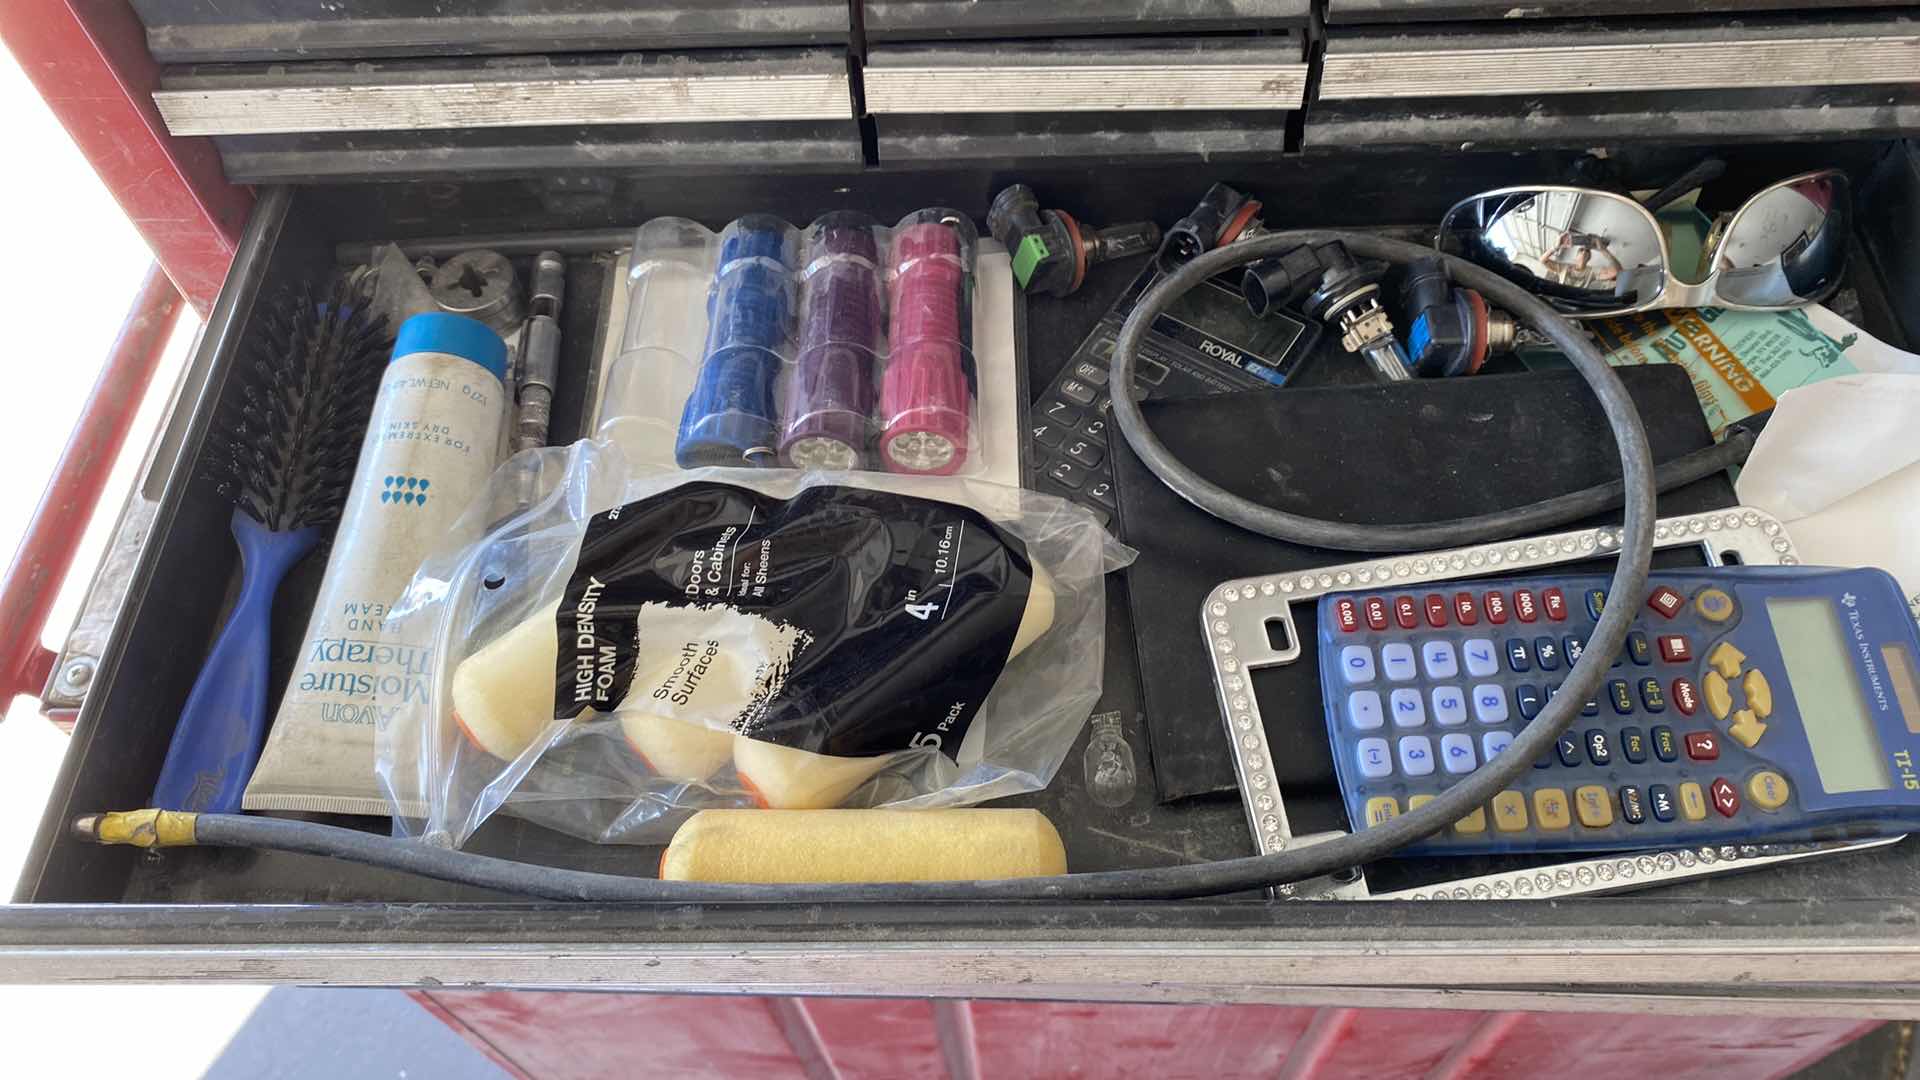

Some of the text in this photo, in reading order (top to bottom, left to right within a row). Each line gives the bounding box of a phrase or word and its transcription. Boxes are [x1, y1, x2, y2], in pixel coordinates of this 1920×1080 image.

[1199, 340, 1243, 368] ROYAL
[1047, 400, 1065, 416] 7
[389, 422, 416, 430] SKIN
[1032, 425, 1048, 437] 4
[1069, 440, 1087, 456] 5
[688, 549, 705, 596] Doors
[706, 526, 736, 597] & Cabinets
[740, 561, 753, 577] for:
[753, 540, 772, 598] All Sheens
[1339, 601, 1352, 625] 0.001
[1370, 602, 1382, 620] 0.01
[1400, 603, 1412, 616] 0.1
[1549, 595, 1560, 609] Fix
[574, 576, 606, 702] HIGH DENSITY
[310, 639, 431, 675] Therapy
[1349, 657, 1364, 667] 0
[1431, 651, 1448, 663] 4
[1470, 650, 1488, 661] 7
[1846, 608, 1889, 711] TEXAS INSTRUMENTS
[596, 645, 617, 701] FOAM
[653, 641, 699, 700] Smooth
[671, 639, 720, 707] Surfaces
[300, 672, 431, 703] Moisture
[1678, 682, 1694, 709] Mode
[1398, 701, 1415, 712] 2
[1440, 698, 1456, 709] 5
[1481, 696, 1498, 707] 8
[321, 703, 399, 731] Avon
[908, 699, 965, 751] 5 Pack
[1449, 746, 1467, 757] 6
[1591, 733, 1606, 757] Op2
[1628, 735, 1640, 752] Fac
[1658, 731, 1671, 753] Frac
[1695, 738, 1713, 750] ?
[1407, 749, 1424, 759] 3
[1892, 749, 1920, 790] TI-15
[1763, 774, 1776, 801] Clear
